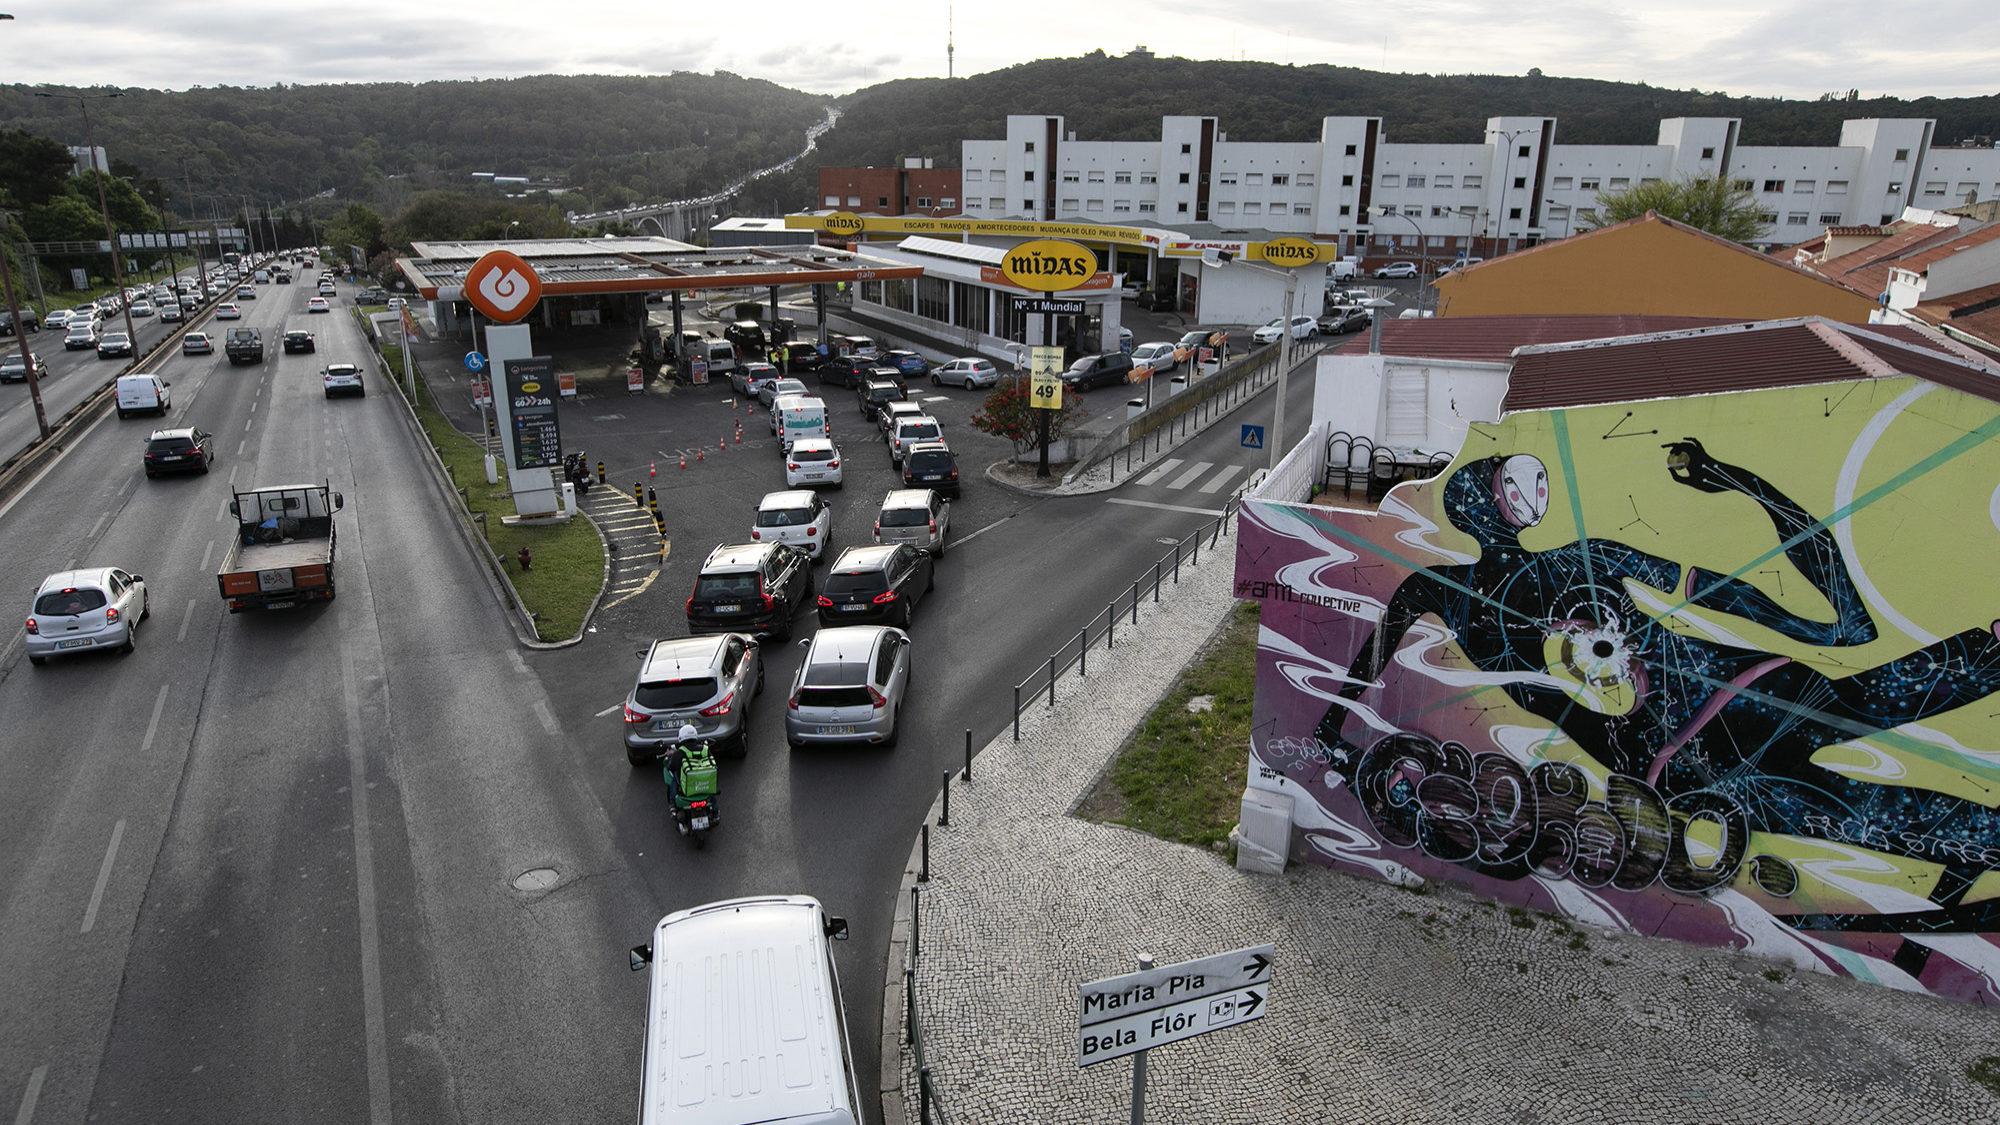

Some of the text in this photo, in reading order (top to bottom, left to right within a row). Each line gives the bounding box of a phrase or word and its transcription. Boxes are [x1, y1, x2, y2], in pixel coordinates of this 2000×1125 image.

[976, 224, 1035, 232] AMORTECEDORES
[1040, 226, 1071, 234] MUDANÇA
[1098, 230, 1117, 238] PNEUS
[1032, 301, 1038, 310] 1
[1042, 301, 1082, 312] Mundial
[1084, 975, 1205, 1015] Maria Pia
[1083, 1013, 1197, 1056] Bela Flôr
